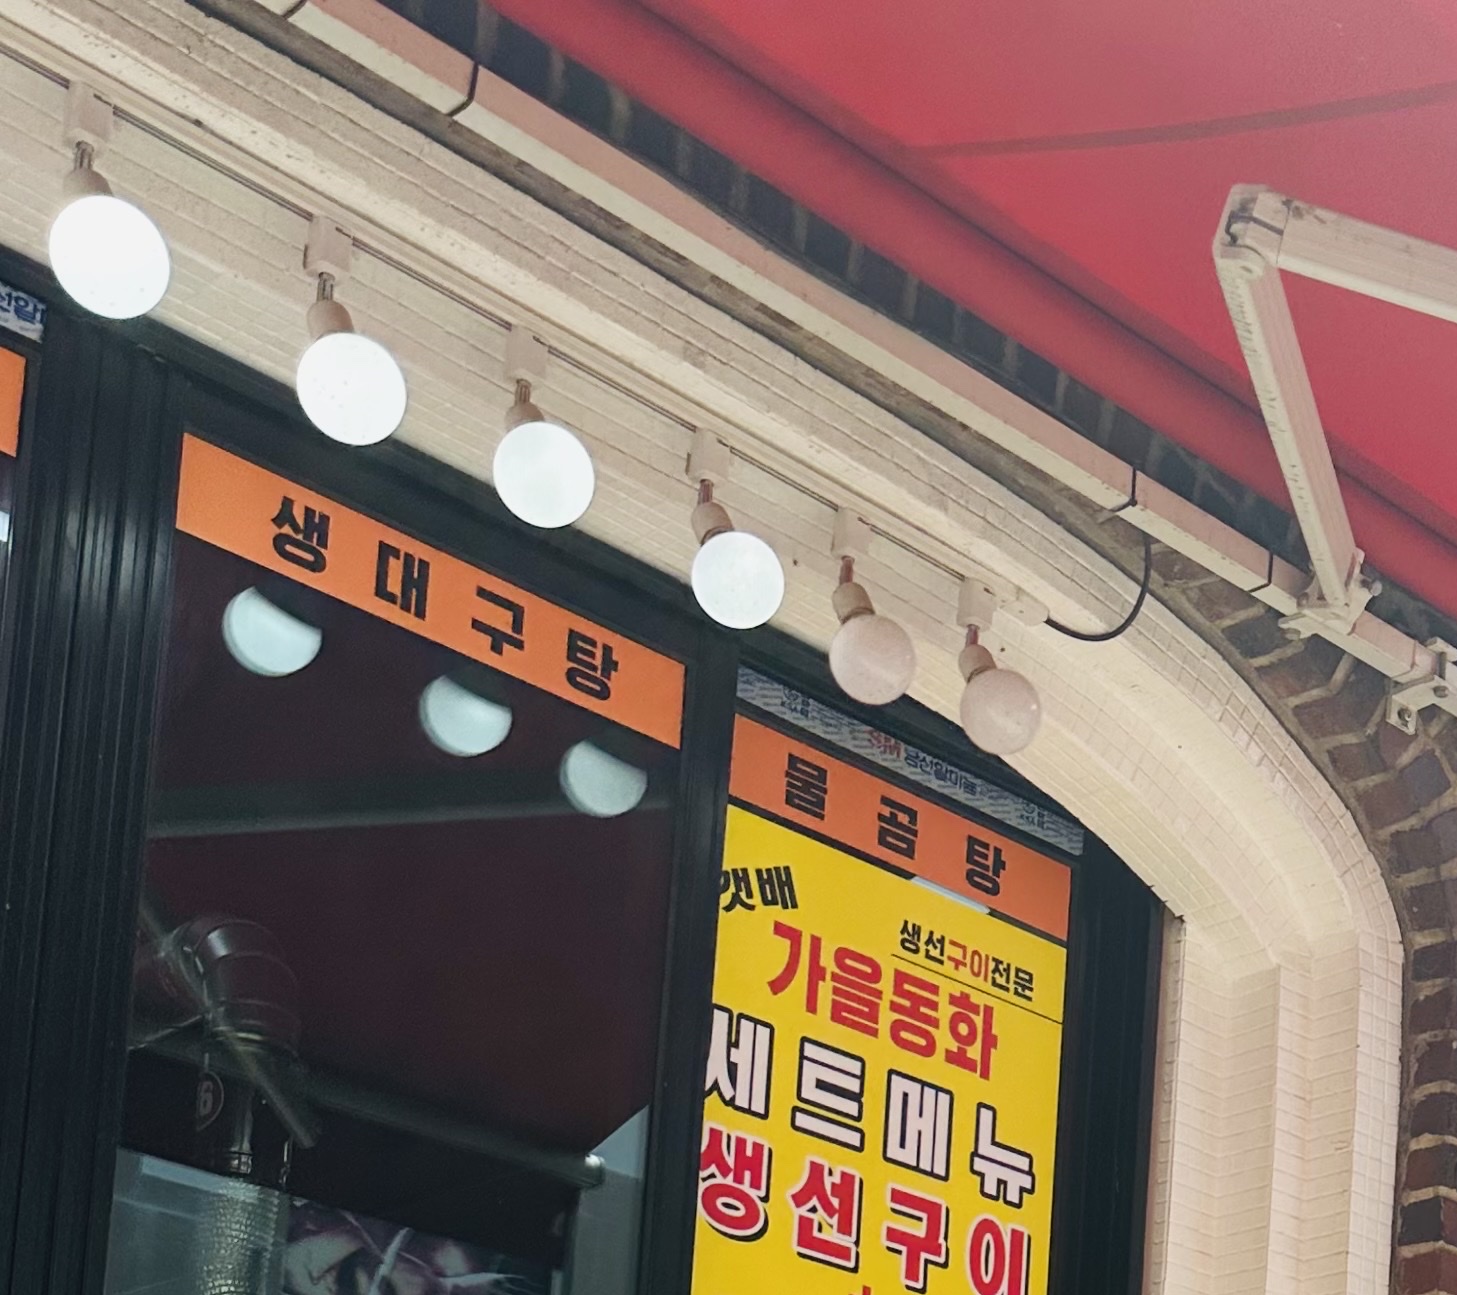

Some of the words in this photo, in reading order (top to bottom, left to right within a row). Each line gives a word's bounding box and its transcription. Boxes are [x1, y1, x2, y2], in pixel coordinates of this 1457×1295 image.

[272, 496, 619, 700] 생대구탕
[785, 752, 1006, 896] 물곰탕
[767, 920, 998, 1081] 가을동화
[900, 919, 1034, 1002] 생선구이전문
[703, 1004, 1035, 1208] 세트메뉴
